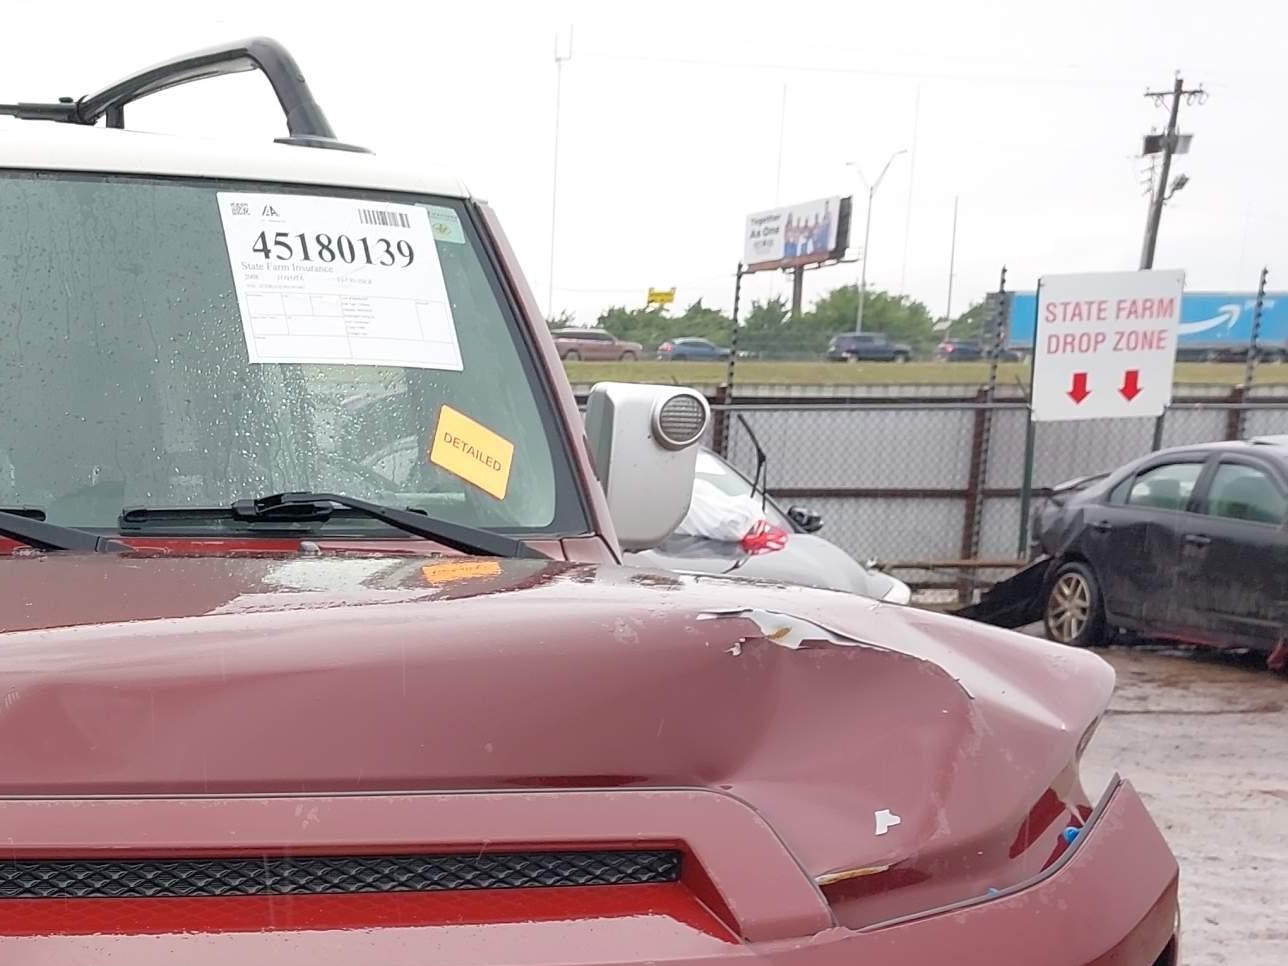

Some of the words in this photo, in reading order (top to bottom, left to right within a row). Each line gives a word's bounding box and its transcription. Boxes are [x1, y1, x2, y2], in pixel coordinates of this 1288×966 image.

[252, 230, 415, 268] 45180139
[240, 261, 265, 271] State
[266, 262, 290, 272] Farm
[291, 262, 334, 273] Insurance
[1044, 300, 1108, 323] STATE
[1115, 297, 1176, 320] FARM
[1046, 330, 1106, 355] DROP
[1113, 329, 1168, 352] ZONE
[443, 431, 502, 472] DETAILED
